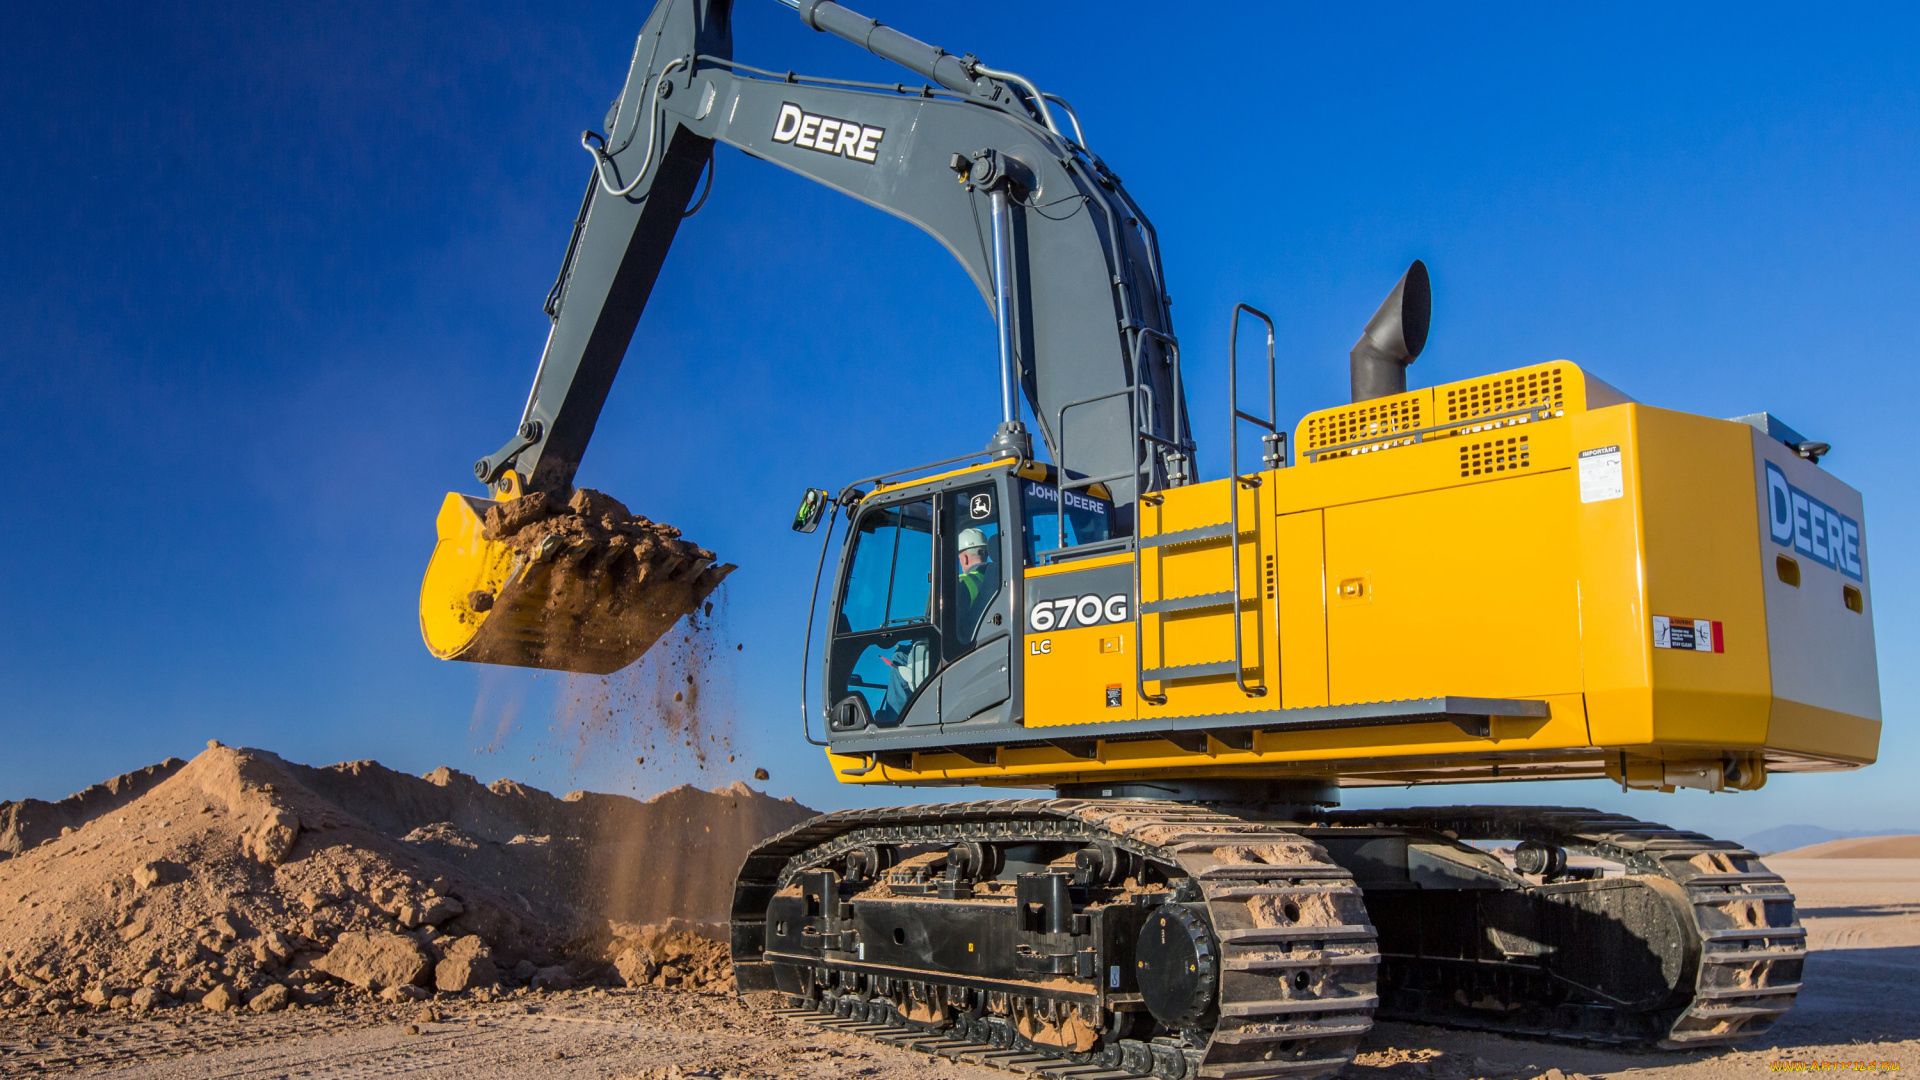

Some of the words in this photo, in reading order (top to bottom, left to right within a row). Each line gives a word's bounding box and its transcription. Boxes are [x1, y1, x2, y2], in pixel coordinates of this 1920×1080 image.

[773, 103, 884, 163] DEERE
[1582, 446, 1617, 457] IMPORTANT
[1028, 482, 1060, 502] JOHN
[1064, 491, 1105, 514] DEERE
[1766, 466, 1862, 577] DEERE
[1030, 594, 1128, 632] 670G
[1031, 639, 1051, 655] LC
